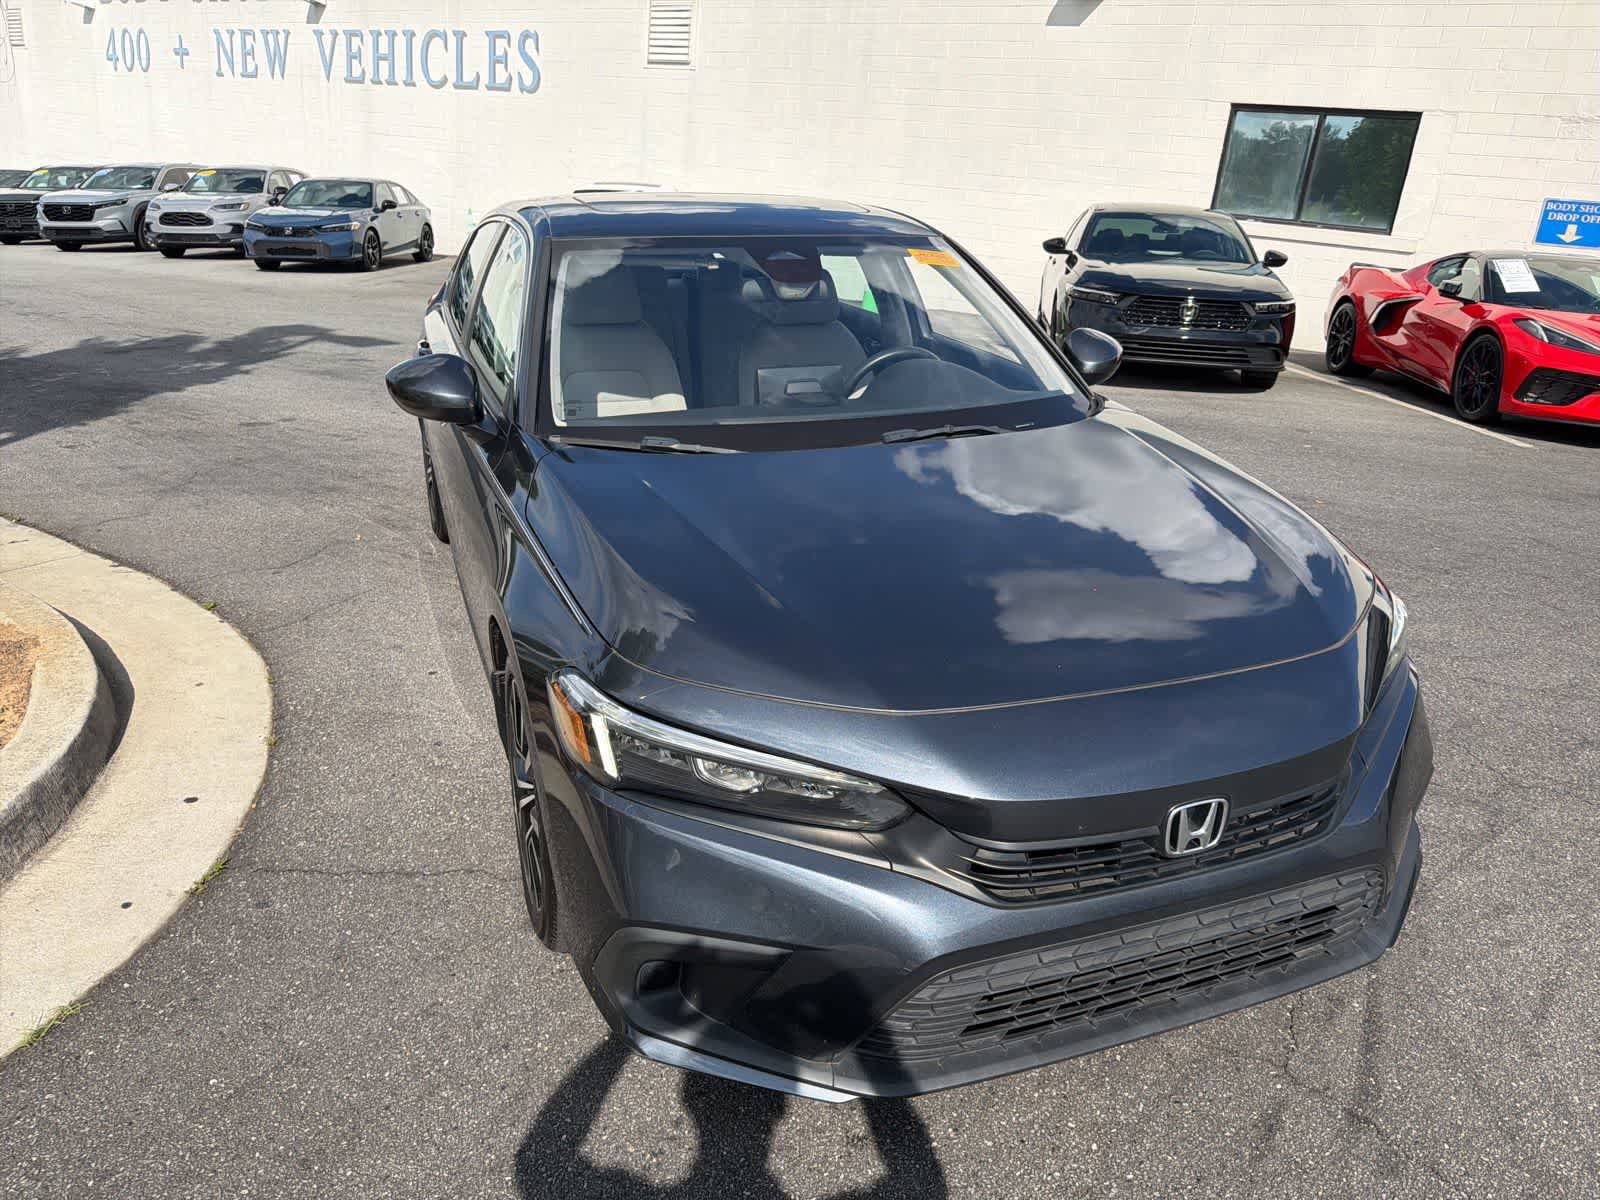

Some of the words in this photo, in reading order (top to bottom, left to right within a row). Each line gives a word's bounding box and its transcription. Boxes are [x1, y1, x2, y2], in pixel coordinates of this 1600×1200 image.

[105, 28, 151, 73] 400
[213, 28, 291, 81] NEW
[312, 28, 542, 94] VEHICLES
[1546, 202, 1577, 212] BODY
[1547, 211, 1580, 222] DROP
